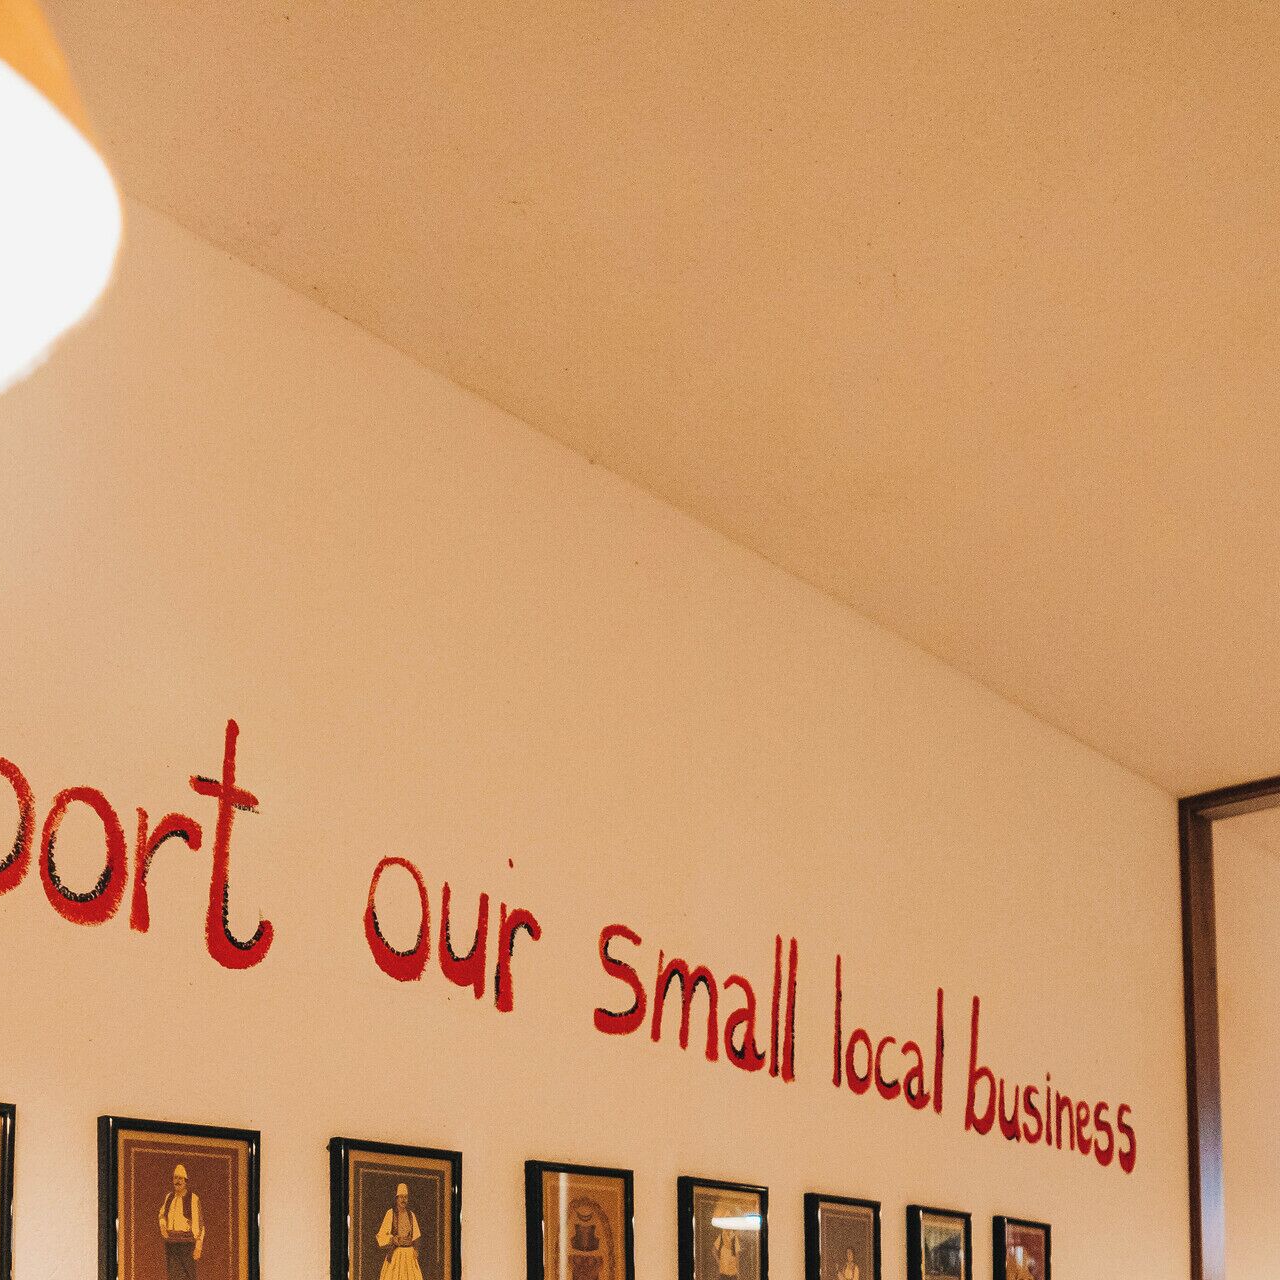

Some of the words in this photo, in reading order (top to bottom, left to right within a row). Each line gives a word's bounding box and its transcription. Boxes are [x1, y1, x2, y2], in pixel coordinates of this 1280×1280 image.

[593, 924, 799, 1083] small
[833, 955, 944, 1113] local
[965, 996, 1137, 1173] business
